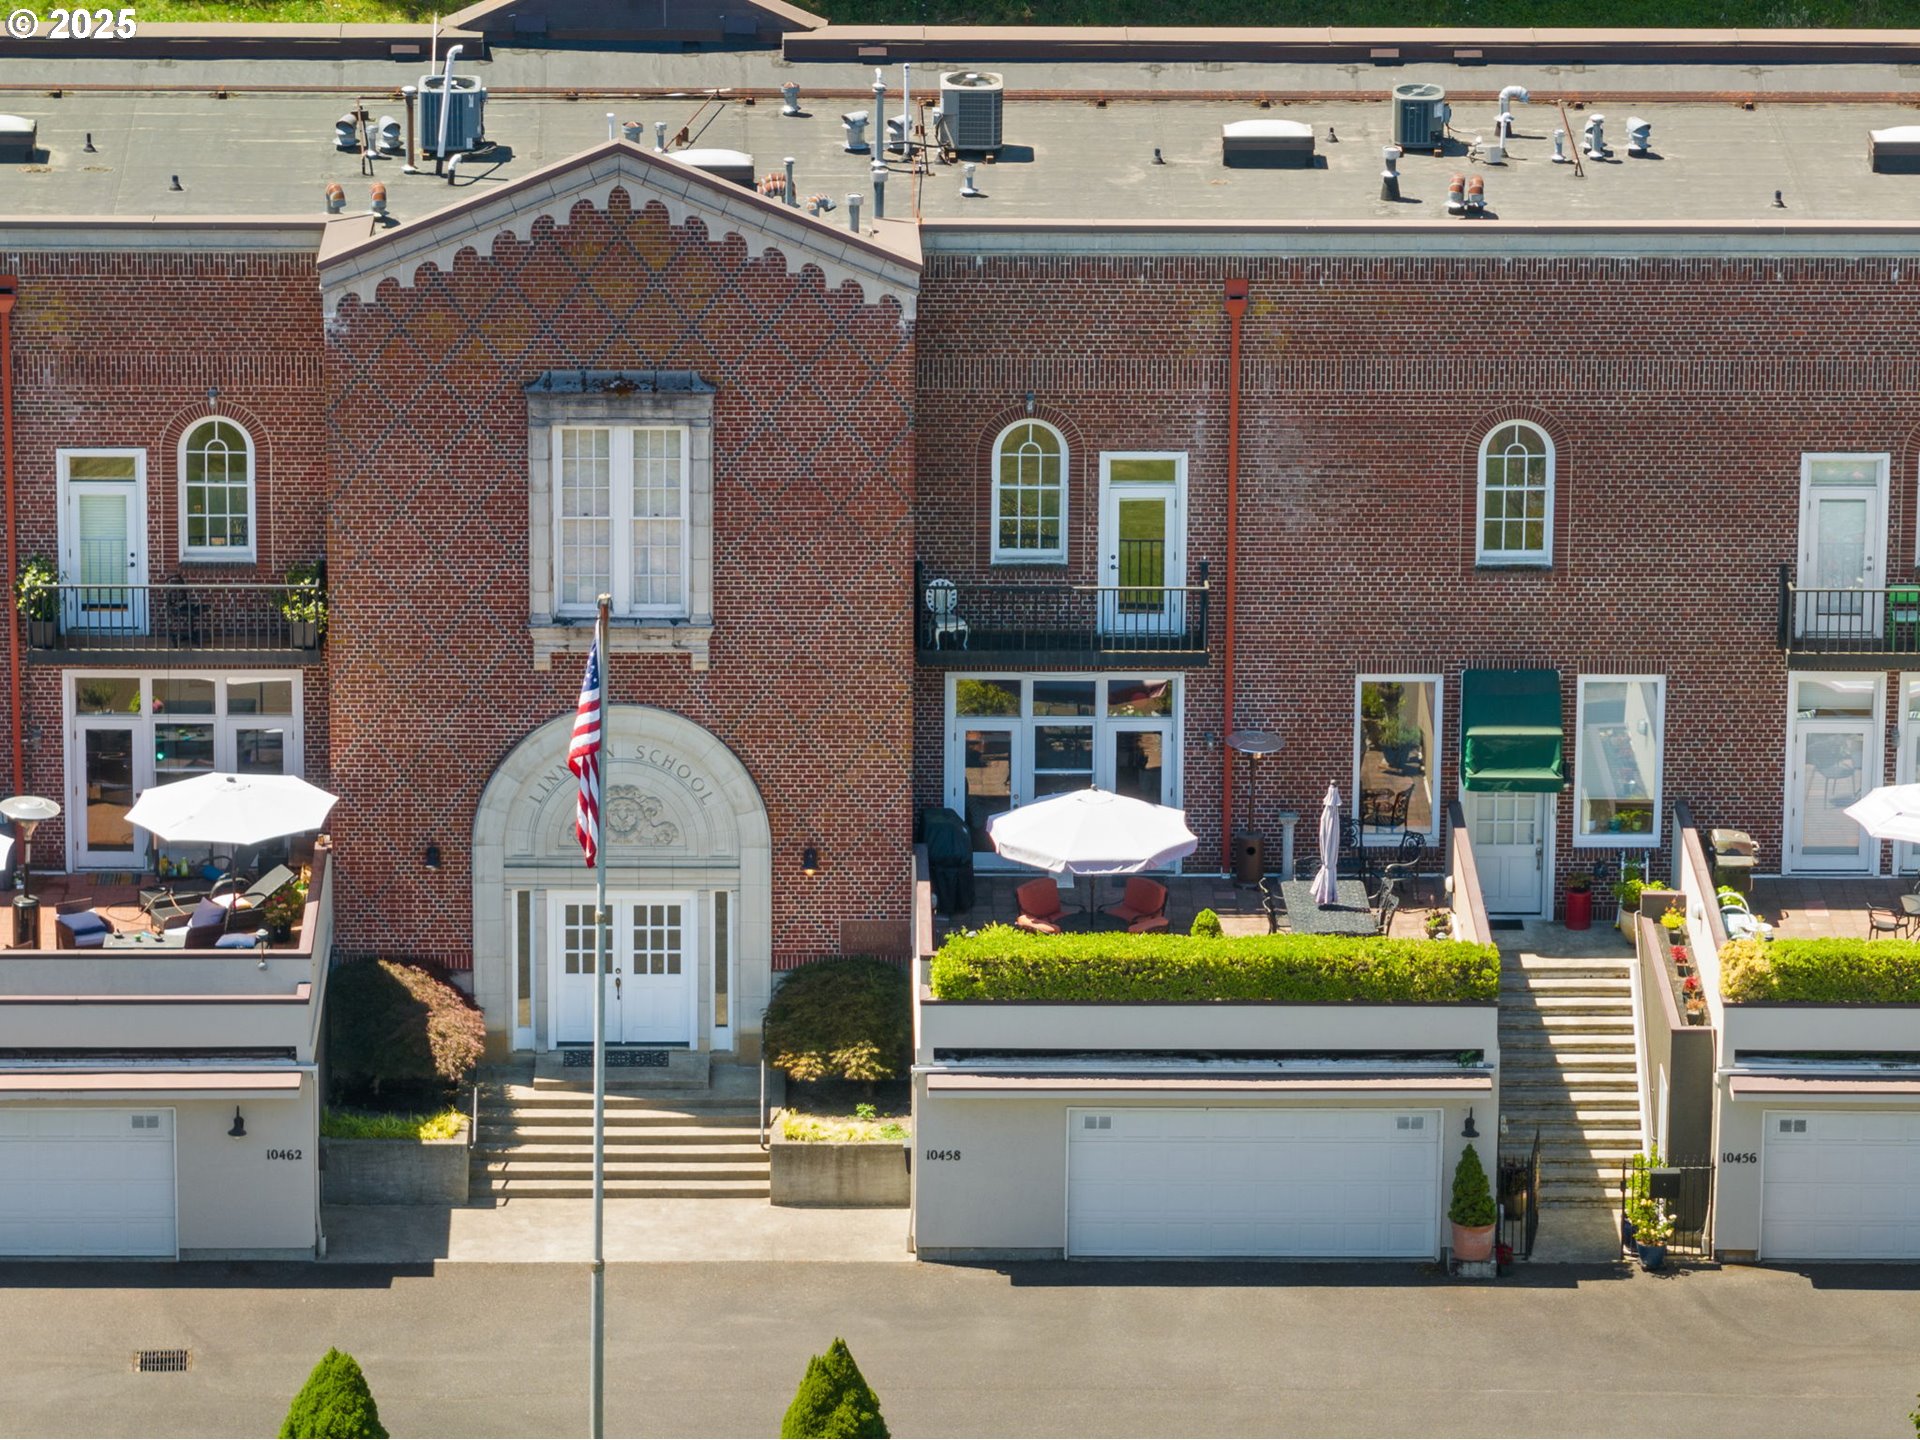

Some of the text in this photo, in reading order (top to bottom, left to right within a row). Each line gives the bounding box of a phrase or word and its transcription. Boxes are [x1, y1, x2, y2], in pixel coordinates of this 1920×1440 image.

[529, 743, 713, 806] LINNN SCHOOL
[266, 1149, 302, 1160] 10462
[926, 1149, 961, 1161] 10458
[1722, 1152, 1757, 1163] 10456
